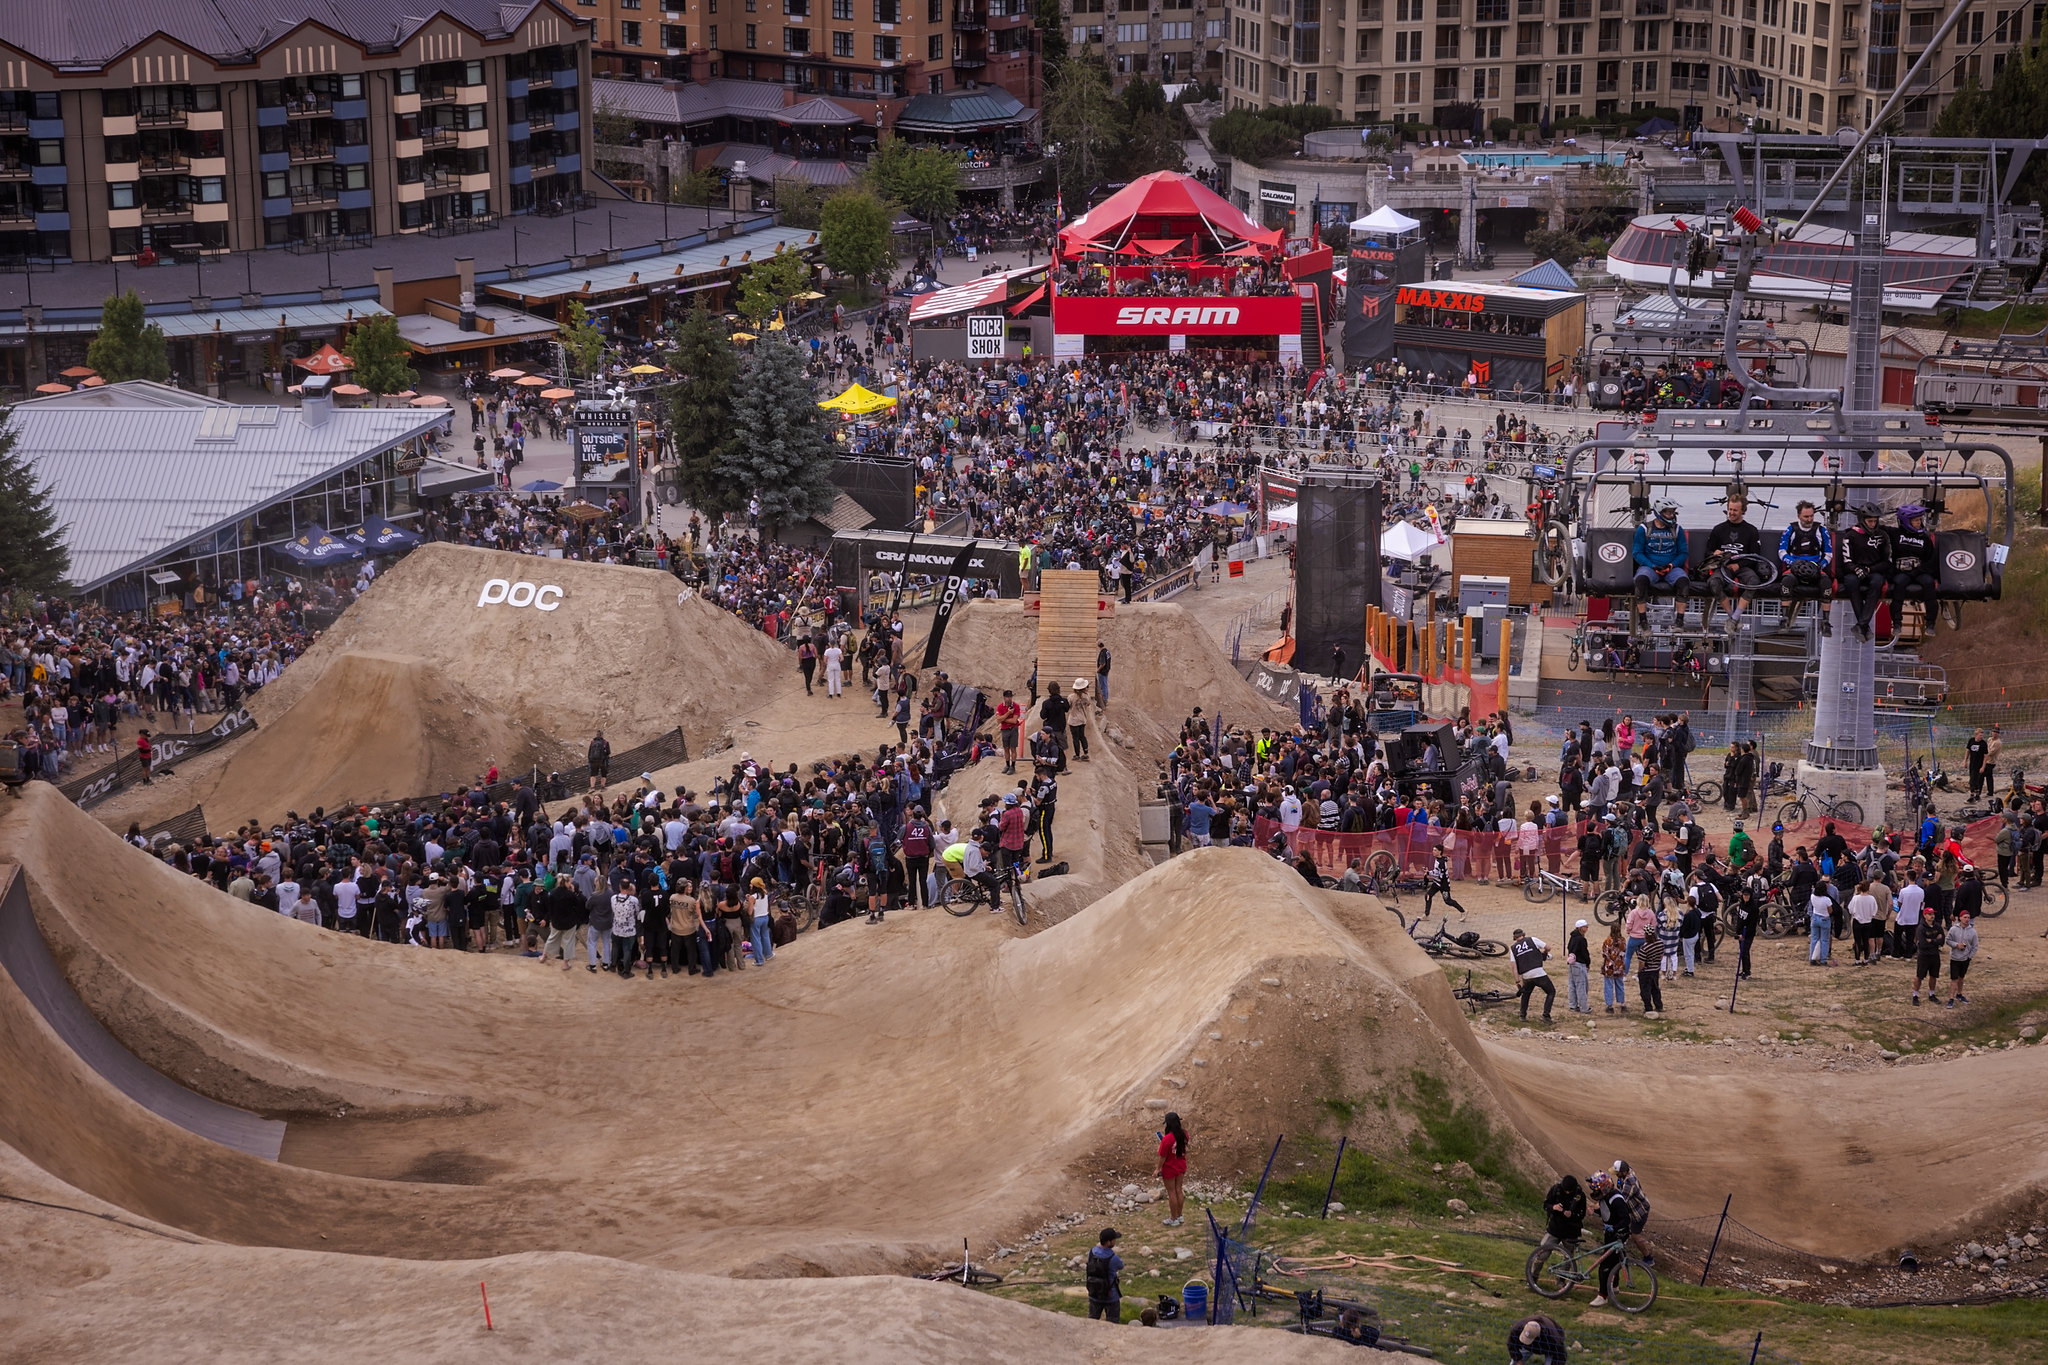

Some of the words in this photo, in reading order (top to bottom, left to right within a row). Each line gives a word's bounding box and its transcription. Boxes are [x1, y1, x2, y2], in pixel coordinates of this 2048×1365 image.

[1261, 192, 1293, 201] SALOMON
[1351, 249, 1394, 261] MAXXIS
[1396, 287, 1485, 312] MAXXIS
[1116, 307, 1240, 325] SRAM
[971, 319, 1001, 336] ROCK
[971, 339, 1001, 355] SHOX
[580, 412, 627, 420] WHISTLER
[581, 435, 619, 444] OUTSIDE
[582, 444, 597, 453] WE
[582, 453, 602, 462] LIVE
[377, 532, 404, 544] Corona
[284, 541, 310, 555] Corona
[313, 542, 346, 556] Corona
[477, 578, 564, 611] POC
[939, 575, 961, 617] POC
[911, 827, 924, 837] 42
[1515, 941, 1529, 953] 24
